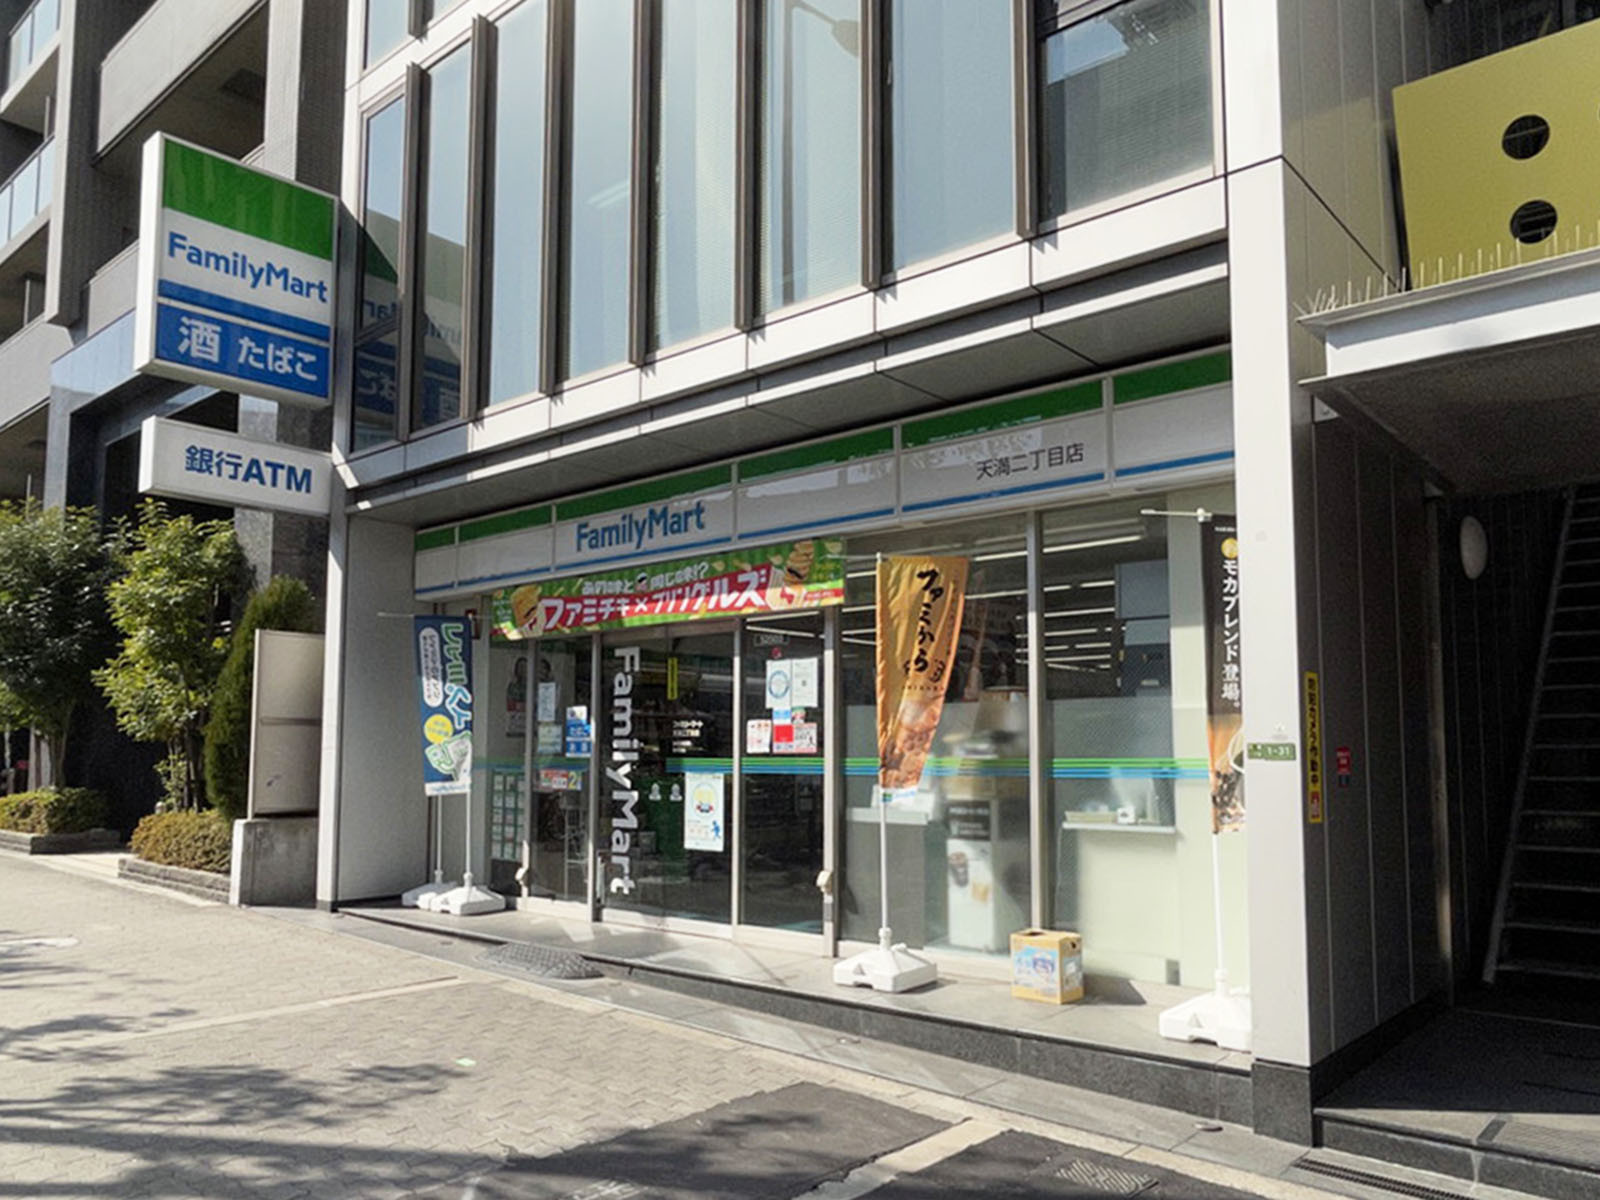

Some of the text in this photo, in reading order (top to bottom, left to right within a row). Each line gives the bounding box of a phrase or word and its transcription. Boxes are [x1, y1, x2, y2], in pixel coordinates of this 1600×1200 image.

[168, 231, 328, 303] FamilyMart
[178, 316, 318, 381] 酒 たばこ
[185, 445, 312, 494] 銀行ATM
[976, 443, 1083, 480] 天満二丁目店
[577, 500, 705, 551] FamilyMart
[914, 567, 945, 673] ファミから
[606, 646, 641, 895] FamilyMart
